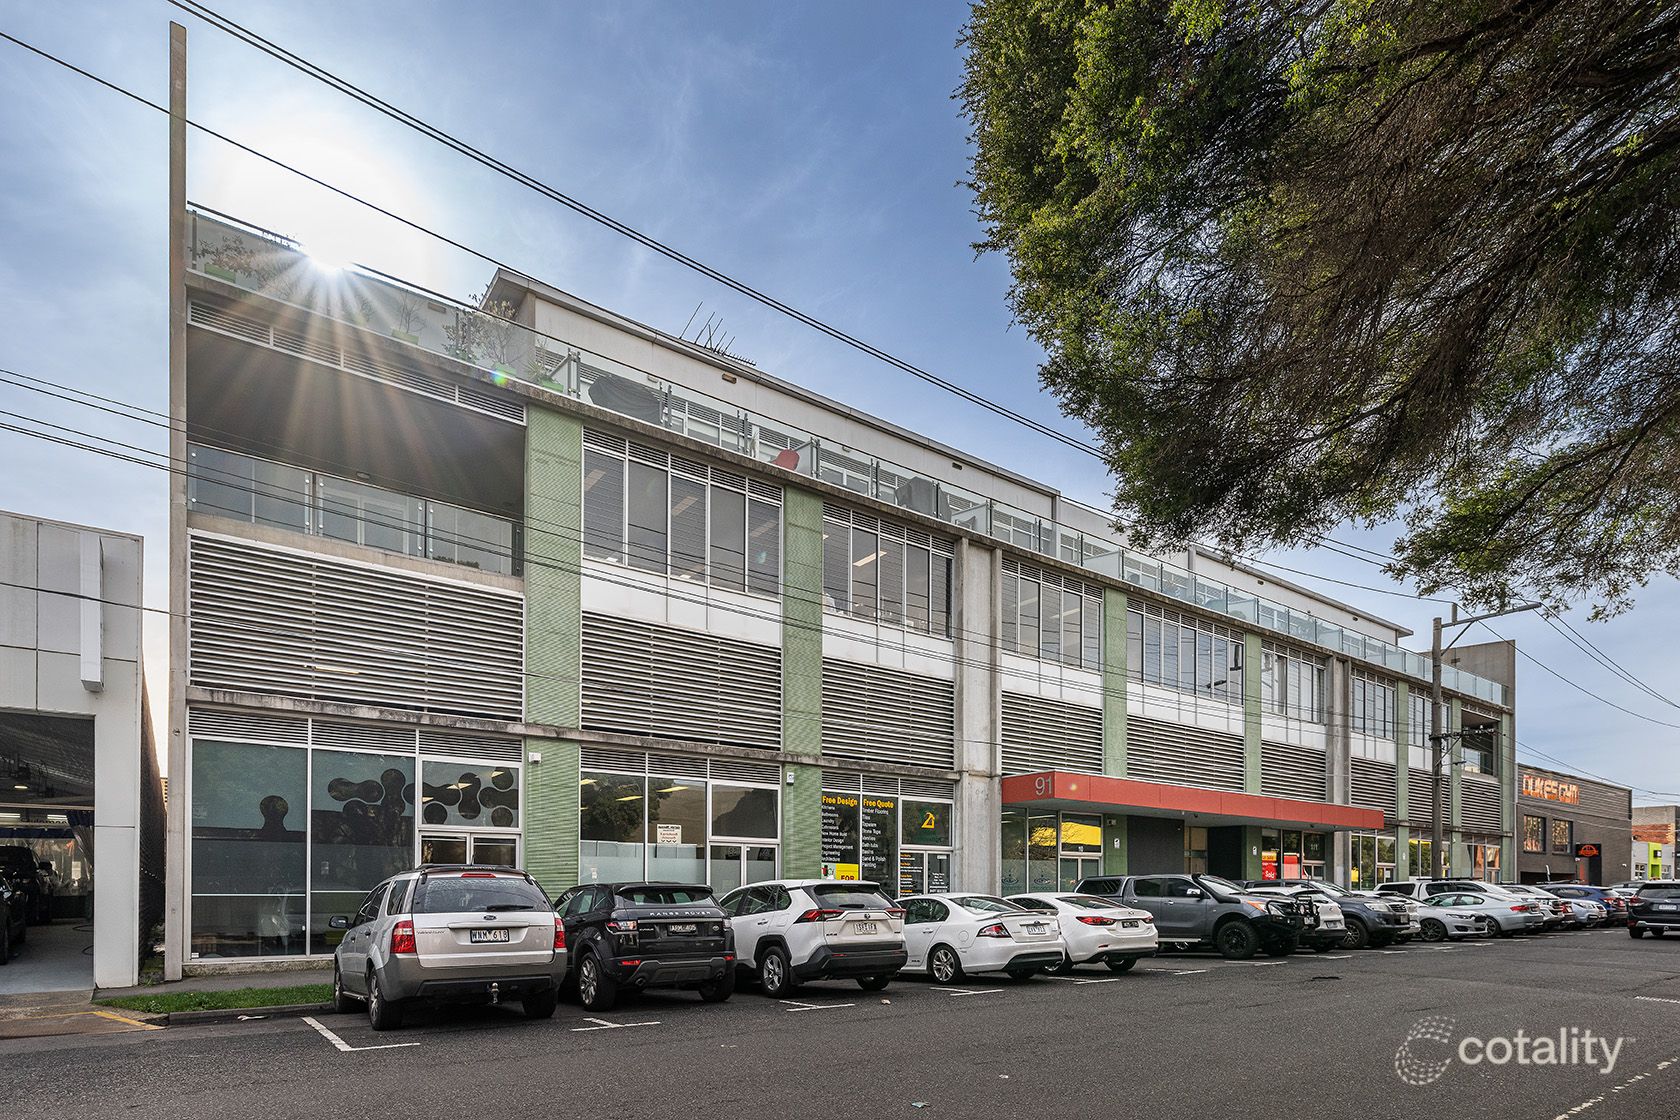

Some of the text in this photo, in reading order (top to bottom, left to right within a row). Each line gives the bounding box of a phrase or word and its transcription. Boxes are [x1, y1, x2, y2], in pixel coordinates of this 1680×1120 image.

[1035, 776, 1052, 796] 91
[822, 795, 857, 807] Free Design
[863, 799, 893, 808] Free Quote
